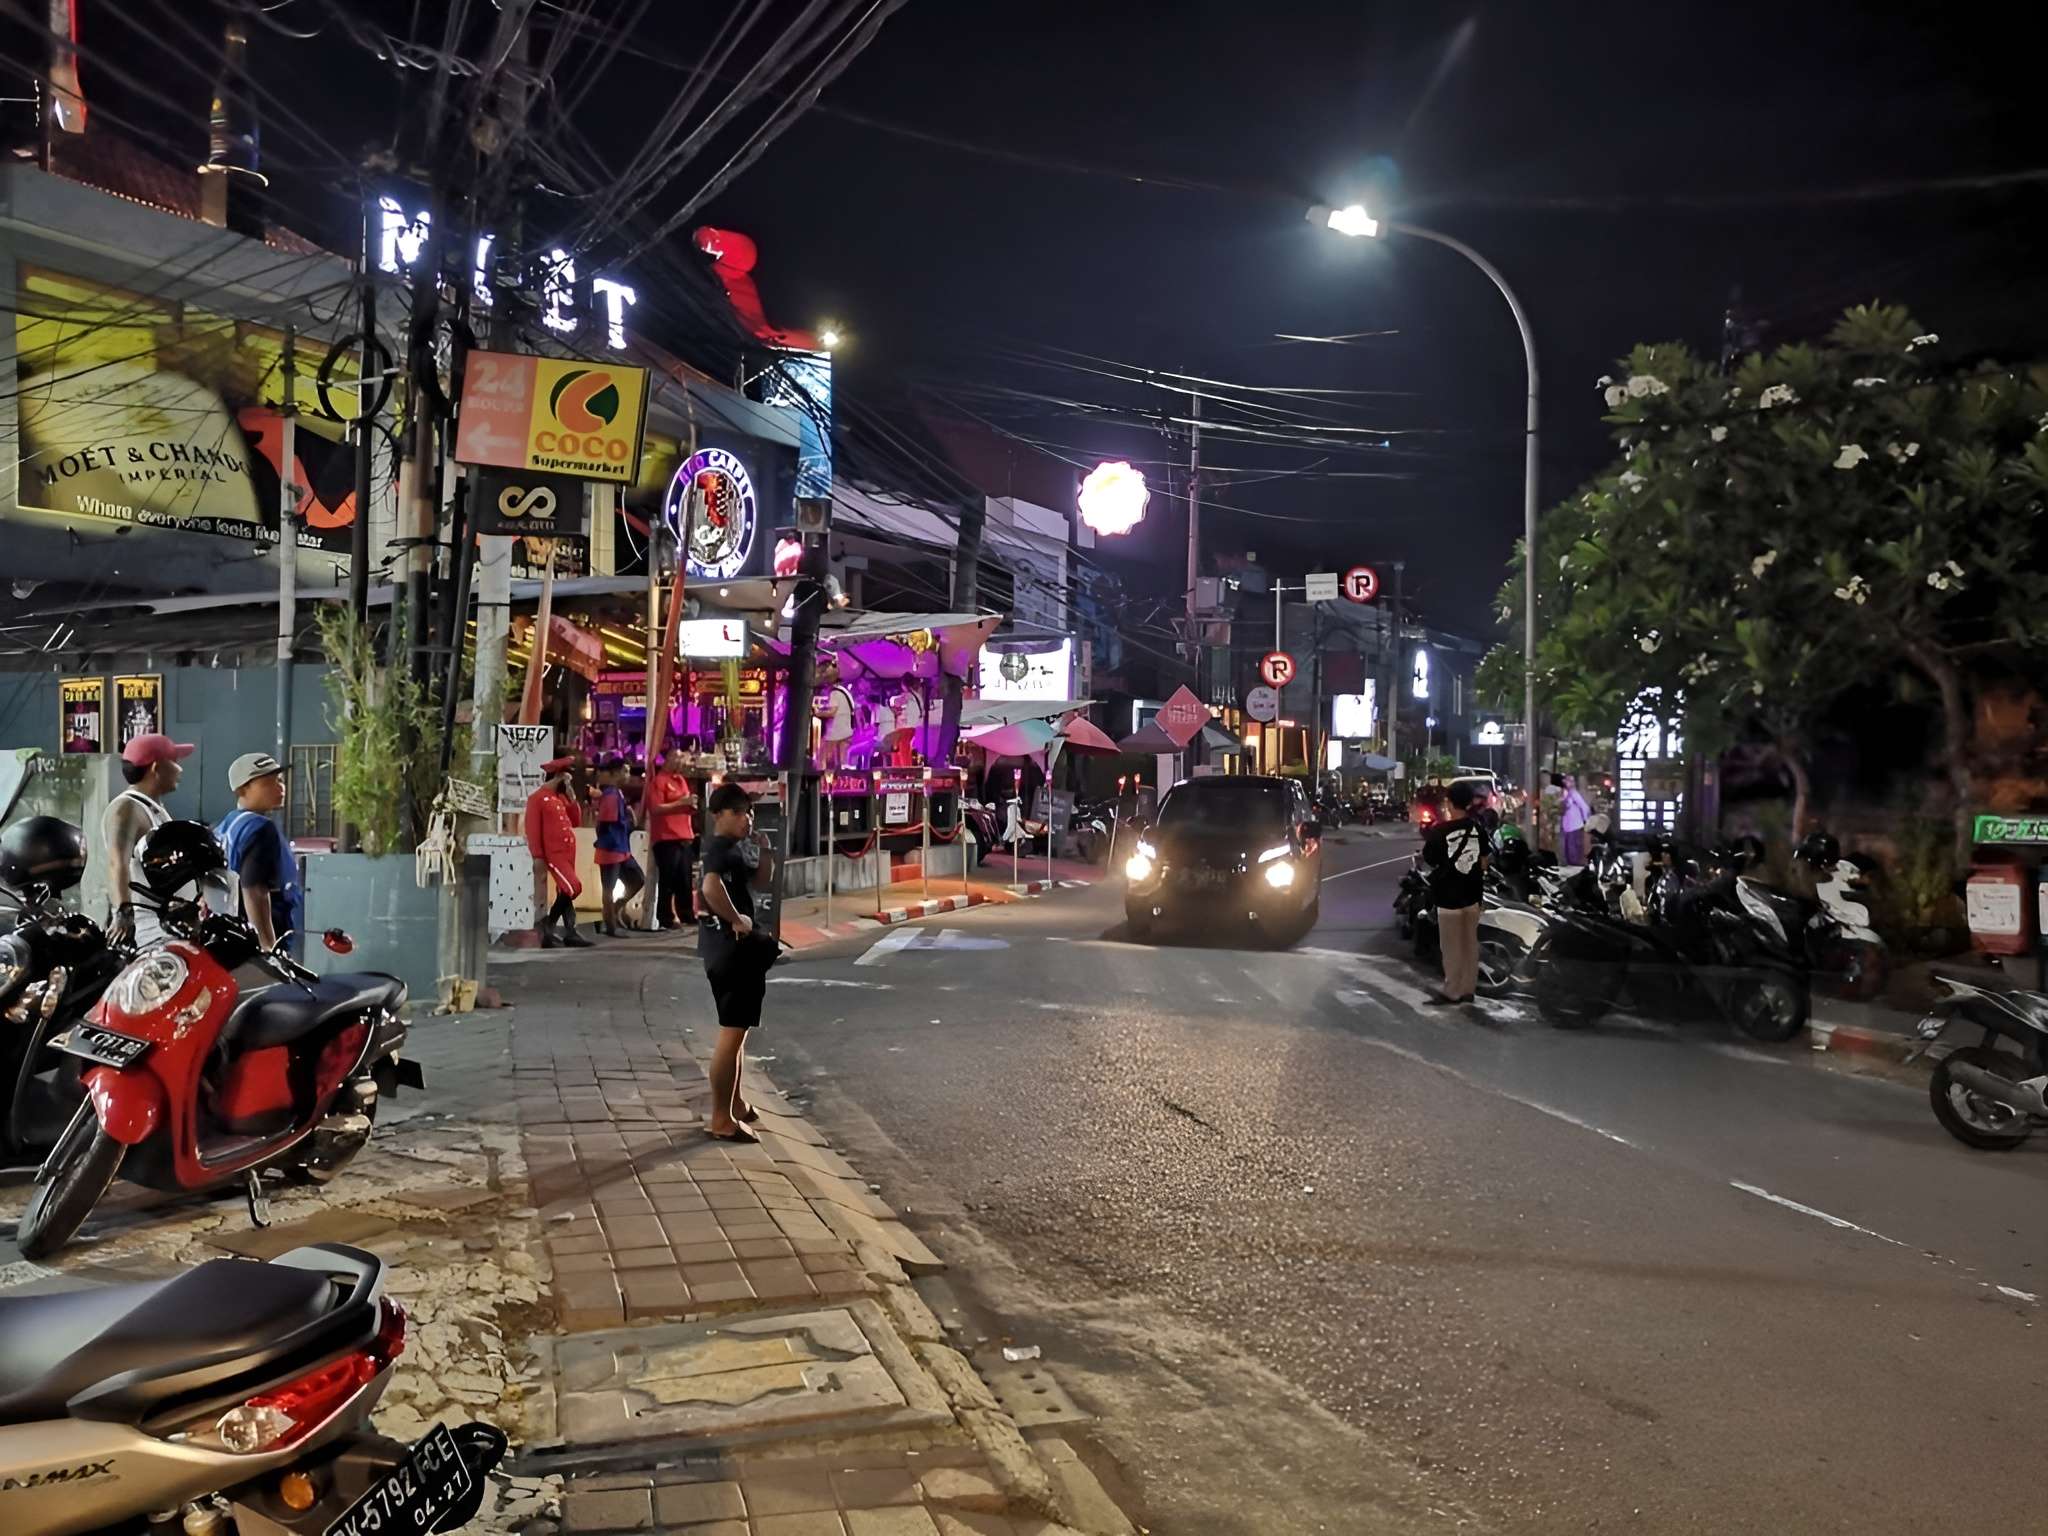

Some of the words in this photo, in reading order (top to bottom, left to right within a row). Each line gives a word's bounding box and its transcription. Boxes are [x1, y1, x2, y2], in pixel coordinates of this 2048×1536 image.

[471, 360, 526, 400] 24
[128, 446, 145, 463] &
[535, 431, 629, 462] COCO
[532, 455, 625, 475] Supermarket
